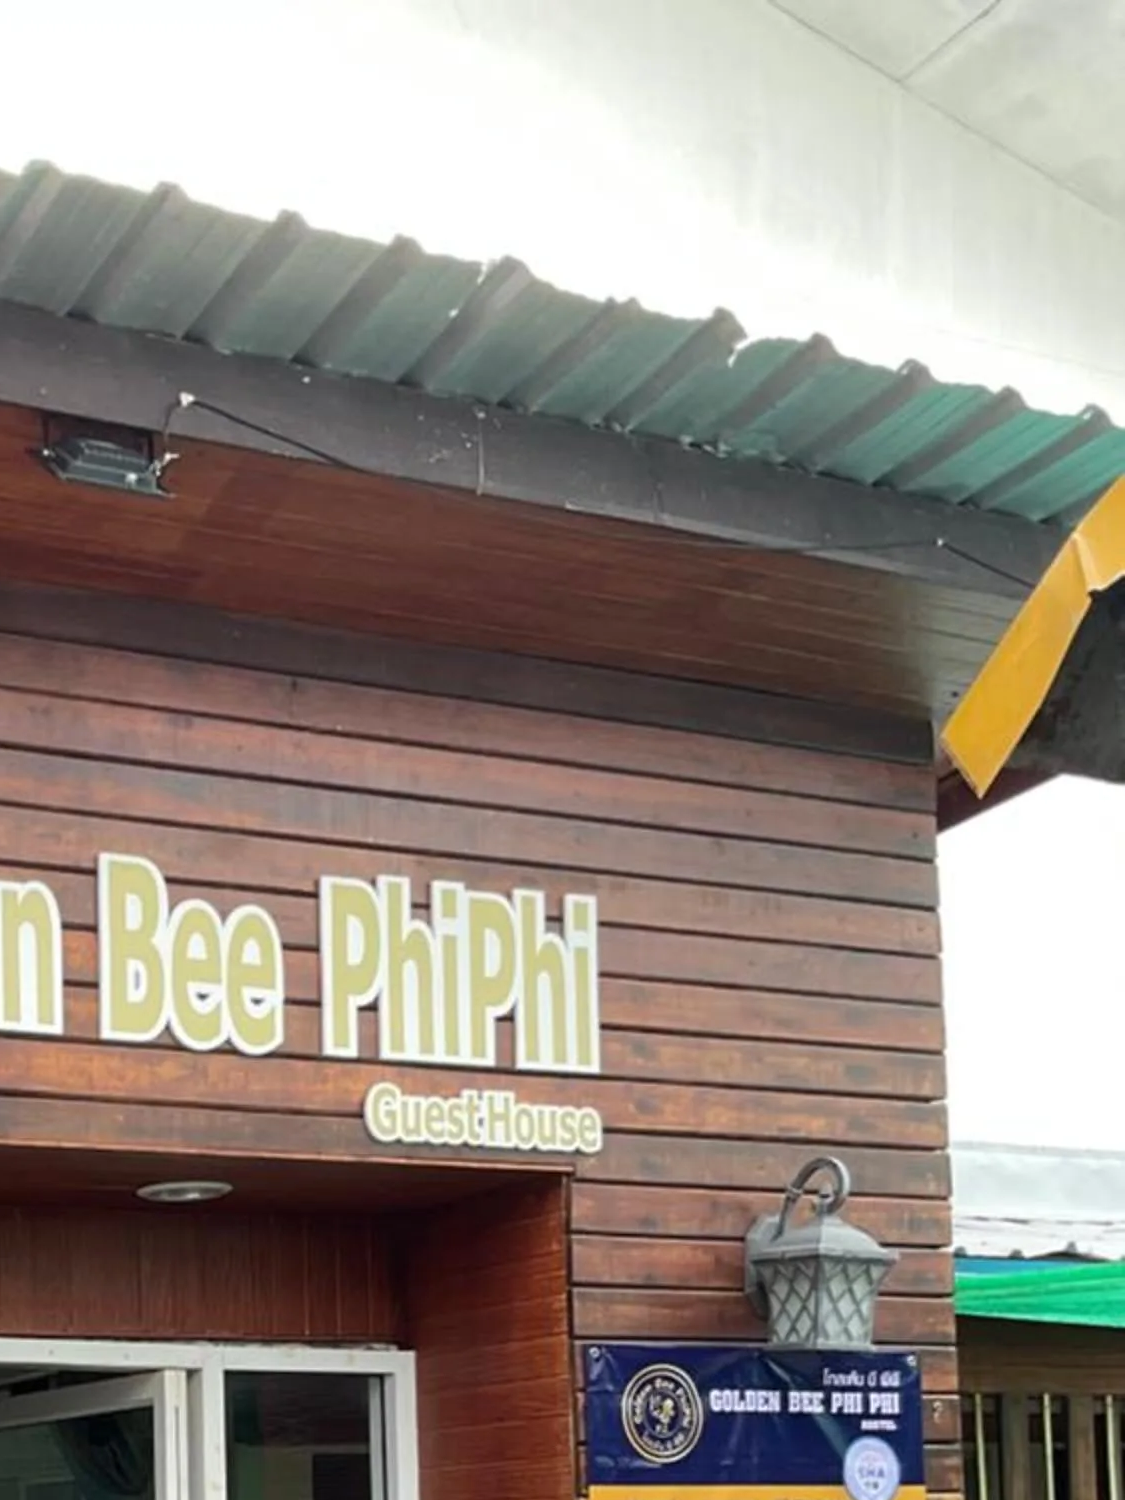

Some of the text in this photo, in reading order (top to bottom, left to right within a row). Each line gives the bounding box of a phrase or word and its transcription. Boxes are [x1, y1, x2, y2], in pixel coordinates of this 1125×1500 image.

[97, 851, 285, 1056] Bee
[318, 874, 601, 1073] PhiPhi
[709, 1389, 900, 1414] GOLDEN BEE PHI PHI
